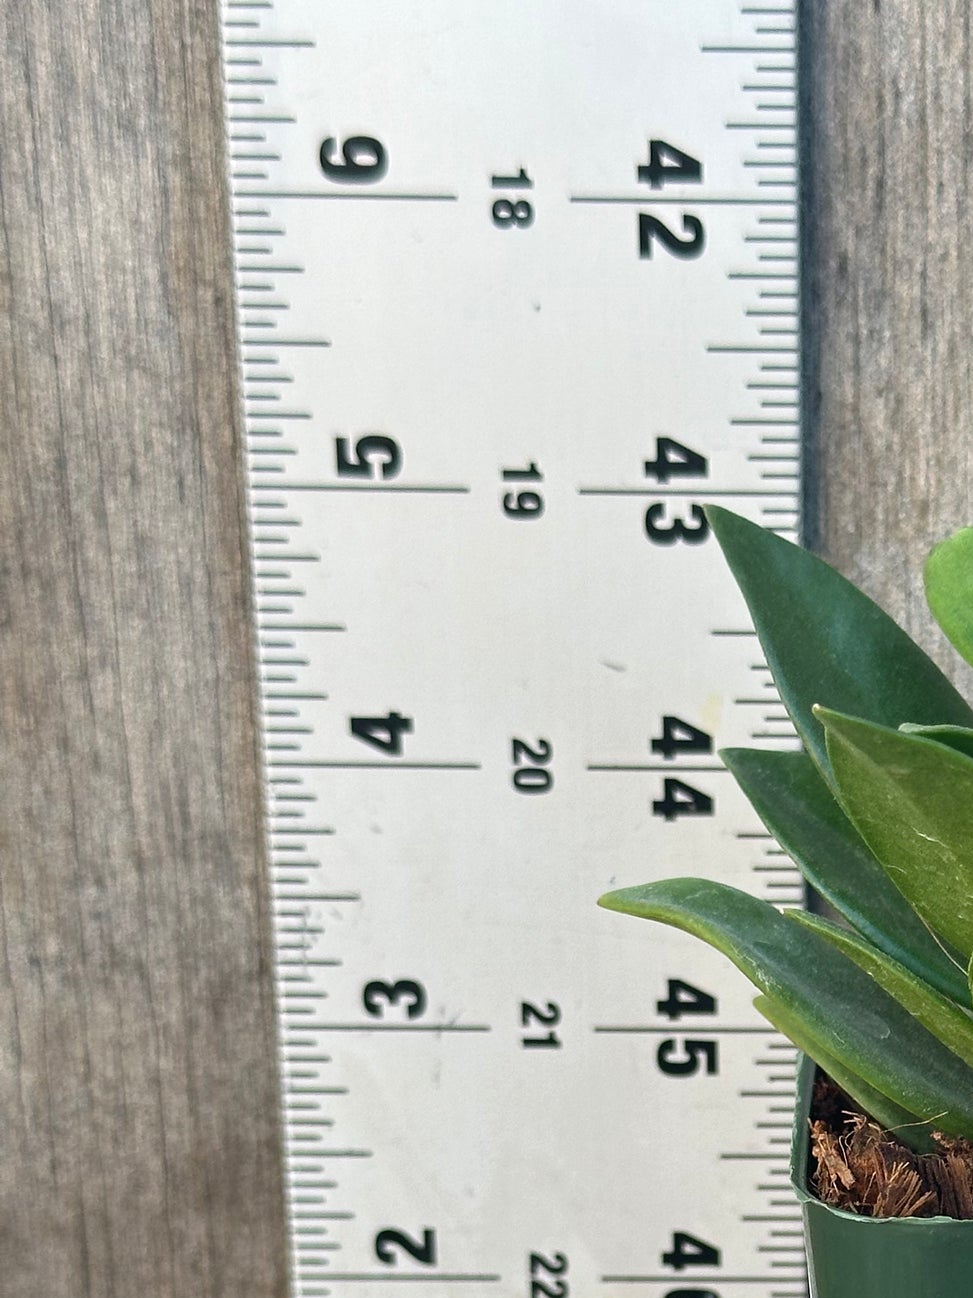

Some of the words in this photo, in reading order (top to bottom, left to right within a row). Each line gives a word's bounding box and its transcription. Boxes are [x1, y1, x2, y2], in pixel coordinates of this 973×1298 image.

[319, 135, 388, 183] 6
[491, 168, 534, 228] 18
[637, 139, 706, 259] 42
[335, 435, 402, 479] 5
[502, 462, 544, 520] 19
[644, 436, 710, 546] 43
[349, 711, 413, 756] 4
[511, 738, 554, 795] 20
[650, 715, 715, 823] 44
[362, 979, 427, 1020] 3
[521, 1002, 562, 1049] 21
[655, 978, 719, 1079] 45
[373, 1228, 437, 1267] 2
